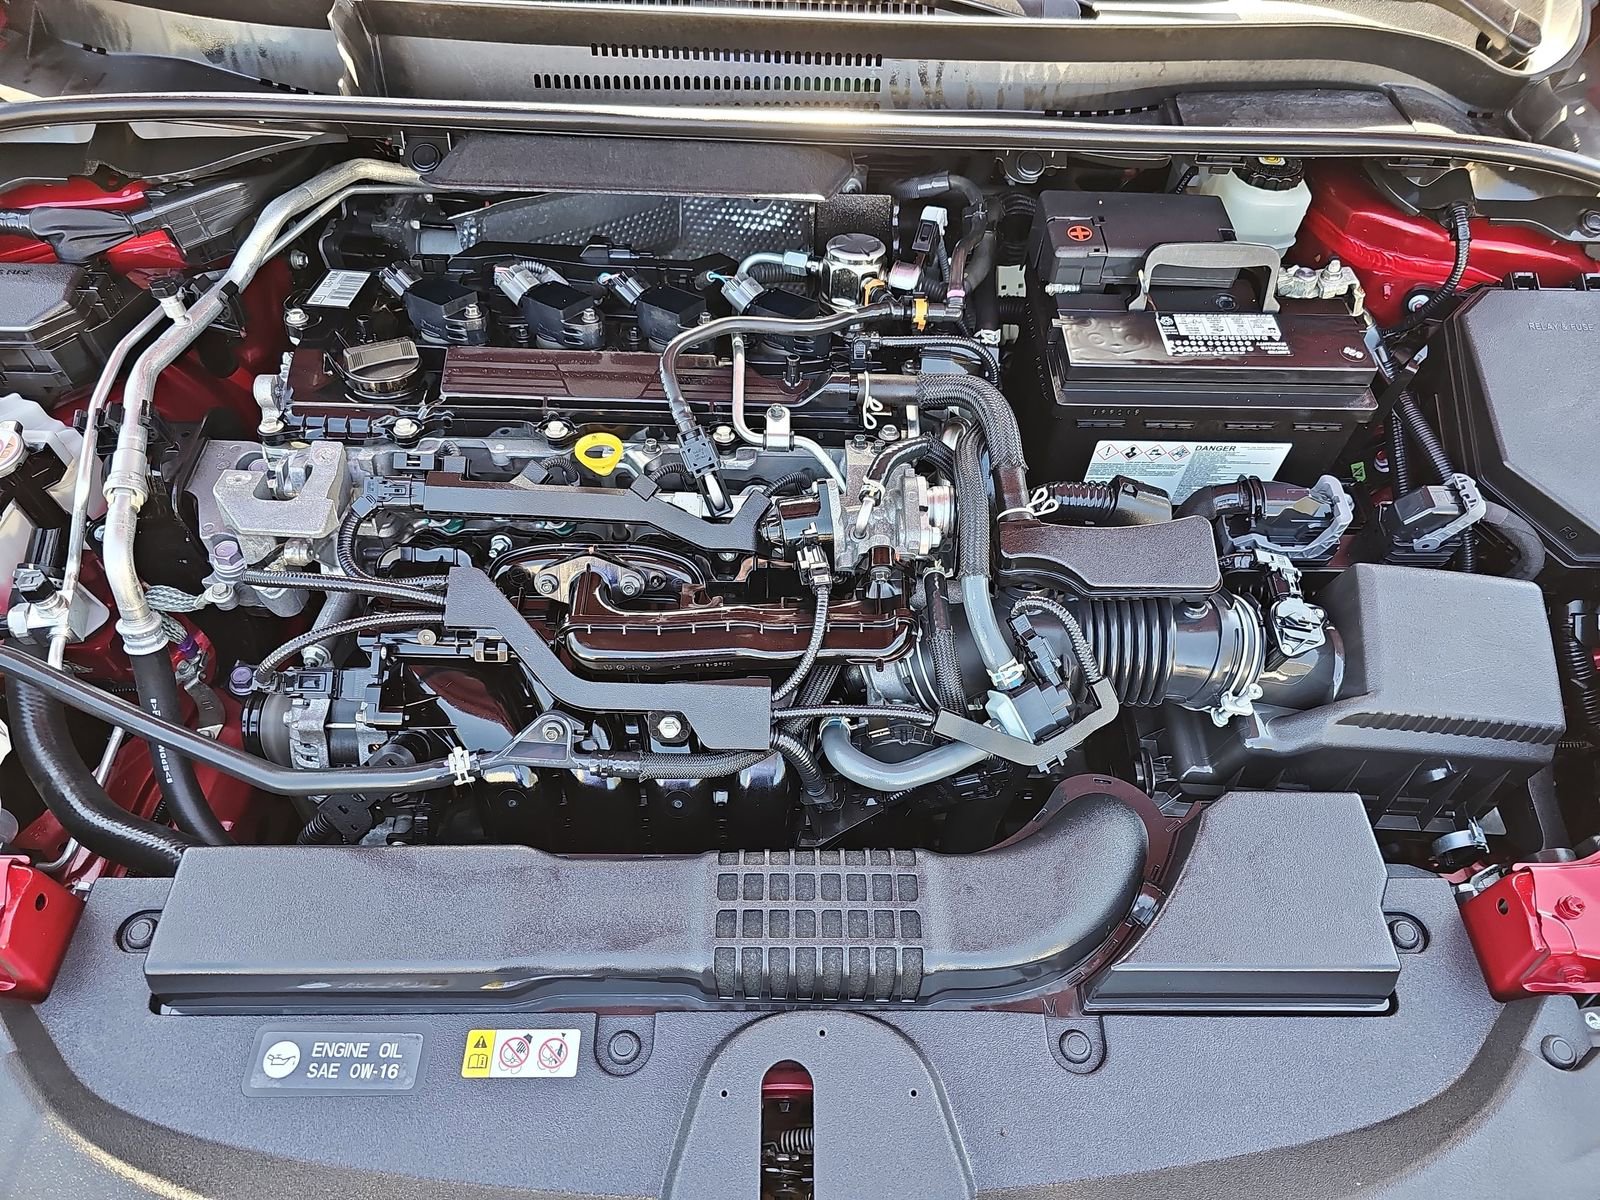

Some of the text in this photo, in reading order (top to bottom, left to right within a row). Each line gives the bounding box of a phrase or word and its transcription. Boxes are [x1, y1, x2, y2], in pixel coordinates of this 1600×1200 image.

[311, 1042, 403, 1058] ENGINE OIL
[307, 1062, 399, 1079] SAE 0W-16
